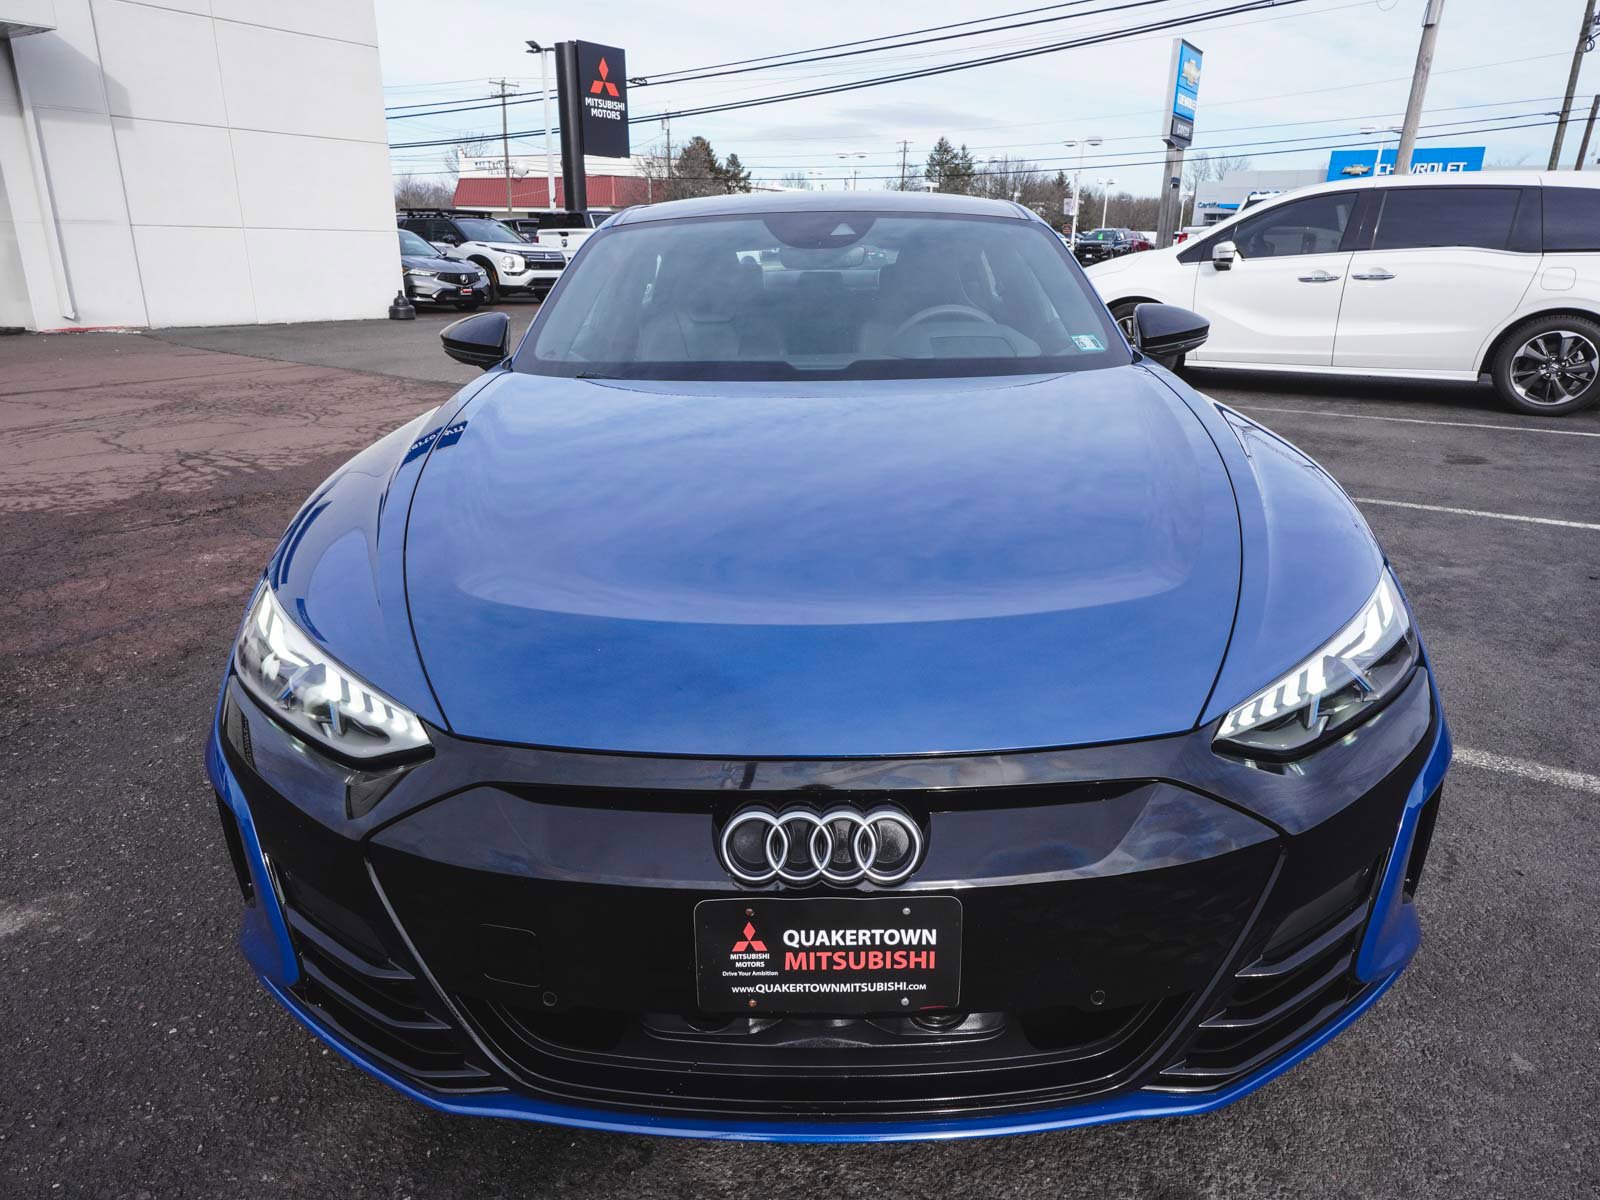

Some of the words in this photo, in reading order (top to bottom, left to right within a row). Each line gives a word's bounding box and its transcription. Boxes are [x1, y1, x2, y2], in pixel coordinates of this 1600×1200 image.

[585, 97, 625, 111] MITSUBISHI
[591, 108, 621, 120] MOTORS
[1375, 162, 1467, 175] CHVROLET
[782, 929, 938, 949] QUAKERTOWN
[784, 951, 936, 971] MITSUBISHI
